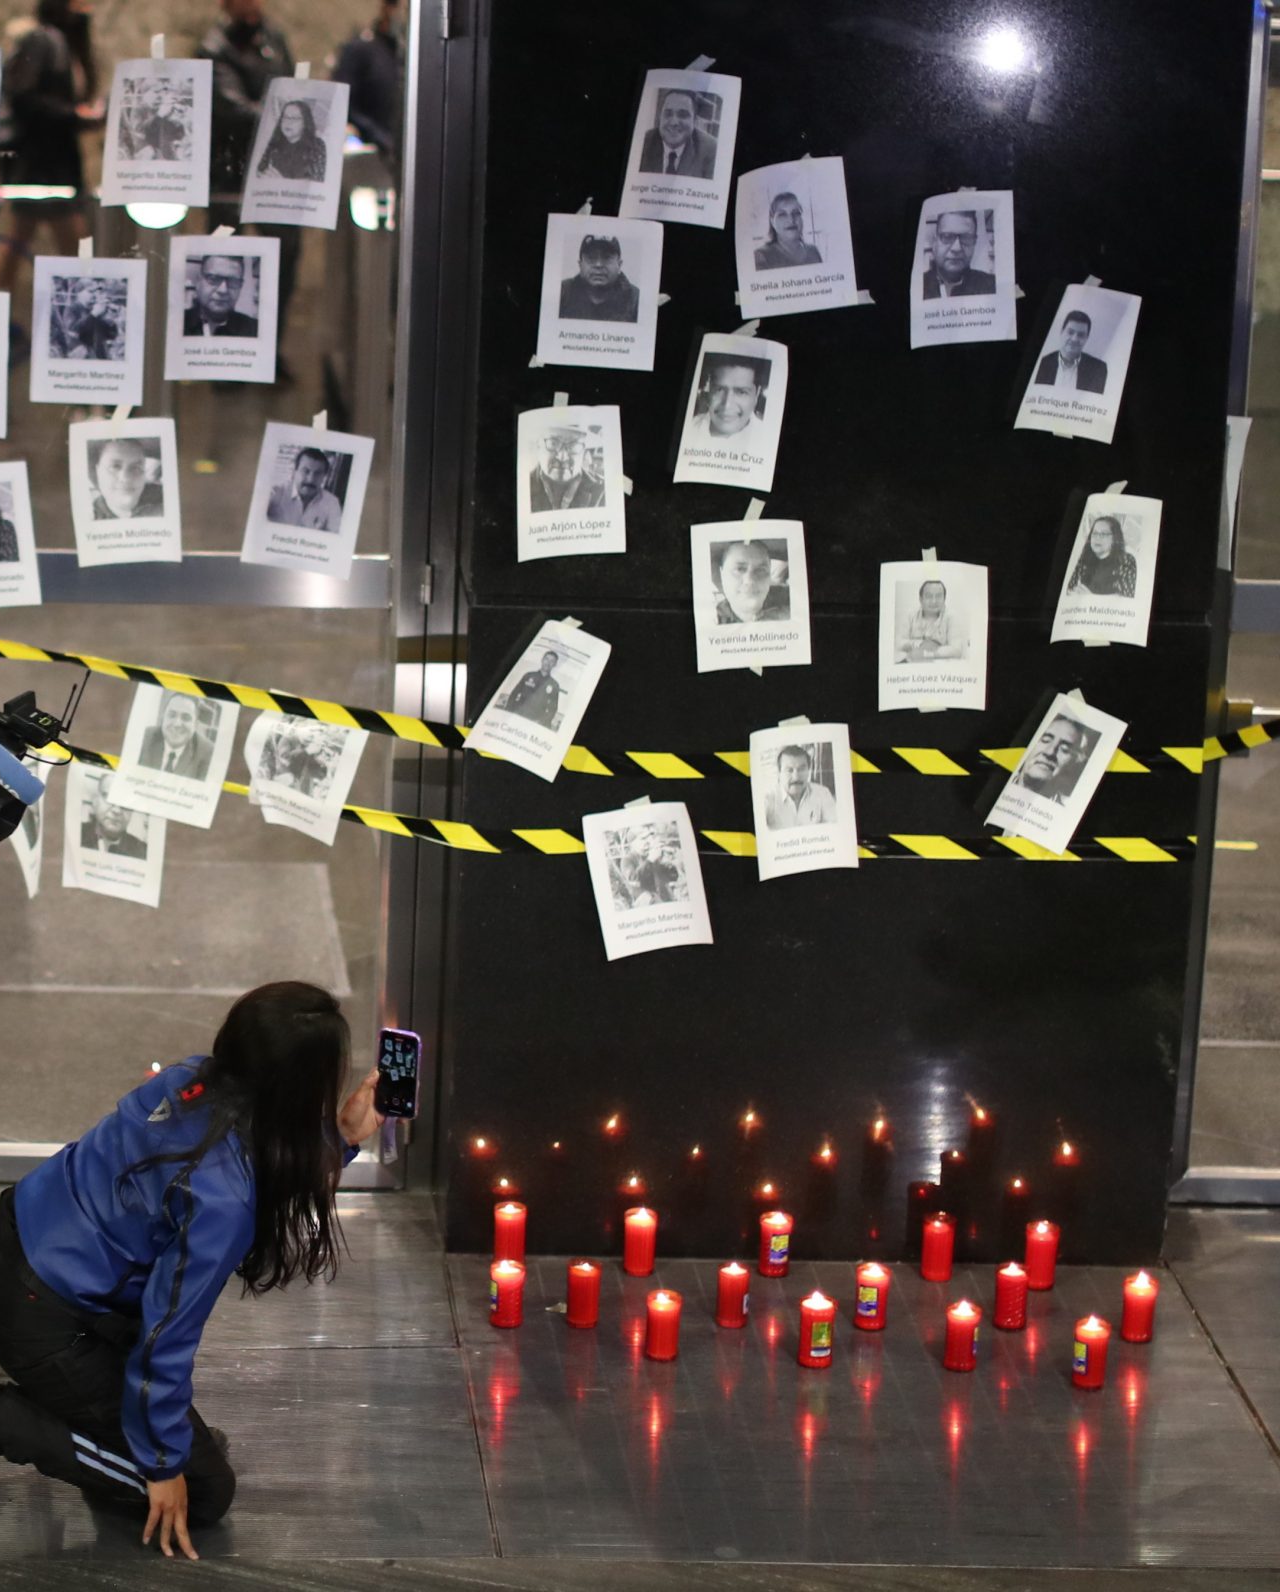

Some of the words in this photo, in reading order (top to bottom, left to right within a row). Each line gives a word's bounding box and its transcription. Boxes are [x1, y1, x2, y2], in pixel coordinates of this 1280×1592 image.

[631, 185, 650, 195] Jorge
[651, 184, 684, 195] Camero
[685, 187, 720, 200] Zazueta
[750, 281, 779, 293] Sheila
[781, 278, 813, 289] Johana
[923, 308, 941, 319] José
[942, 308, 958, 316] Luis
[959, 307, 996, 316] Gamboa
[559, 330, 600, 342] Armando
[602, 332, 635, 343] Linares
[1037, 397, 1069, 409] Enrique
[714, 450, 728, 460] de
[730, 452, 739, 461] la
[740, 454, 764, 465] Cruz
[528, 524, 550, 536] Juan
[551, 522, 578, 532] Arjón
[579, 520, 611, 531] López
[1089, 606, 1136, 617] Maldonado
[708, 635, 747, 646] Yesenia
[749, 631, 799, 642] Mollinedo
[912, 674, 938, 684] López
[940, 674, 977, 684] Vázquez
[776, 838, 800, 849] Fredid
[801, 834, 830, 845] Román
[617, 917, 657, 931] Margarito
